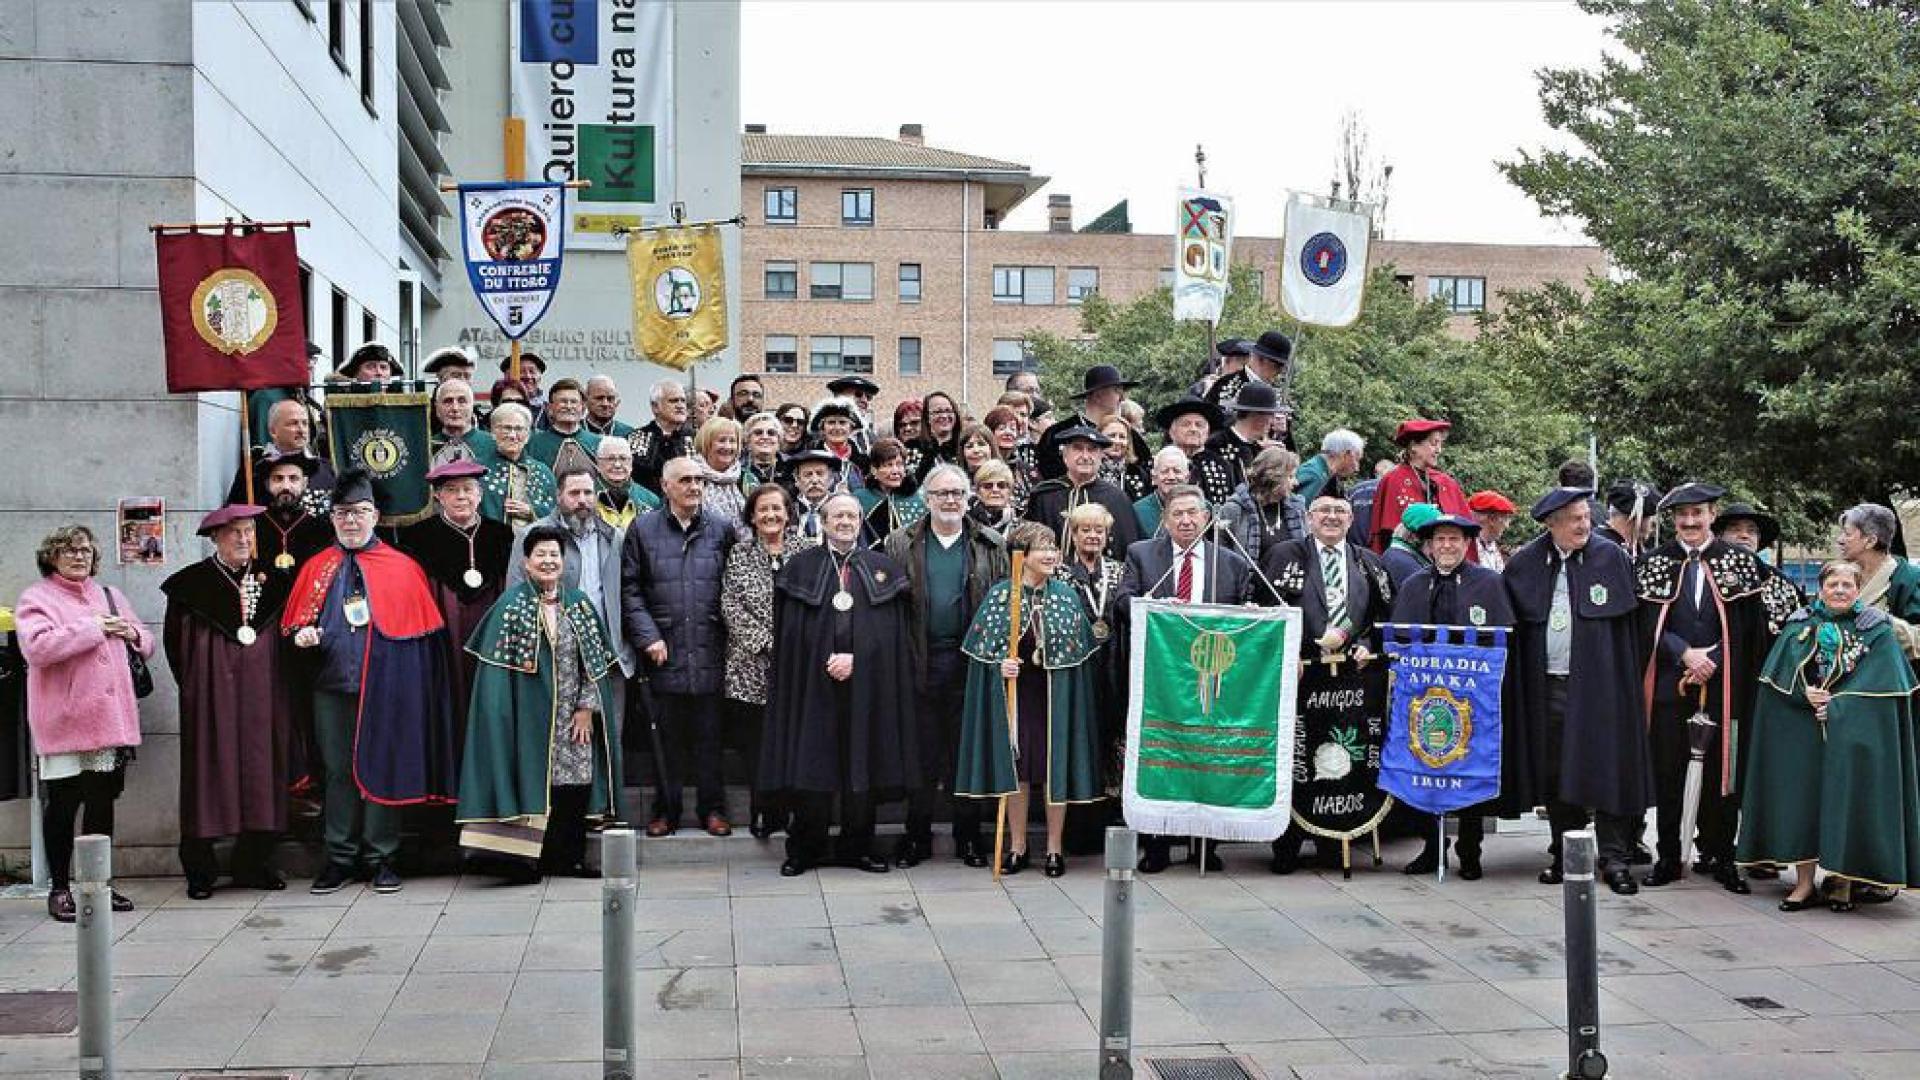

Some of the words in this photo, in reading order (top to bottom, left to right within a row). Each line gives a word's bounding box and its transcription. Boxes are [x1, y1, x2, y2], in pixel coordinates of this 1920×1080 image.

[543, 57, 575, 183] Quiero
[604, 47, 636, 189] Kultura
[478, 264, 551, 276] CONFRERIE
[484, 278, 502, 289] DU
[1400, 656, 1490, 673] COFRADIA
[1410, 672, 1476, 688] ANAKA
[1306, 689, 1365, 712] AMIGOS
[1411, 775, 1462, 789] IRUN
[1312, 792, 1365, 815] NABOS
